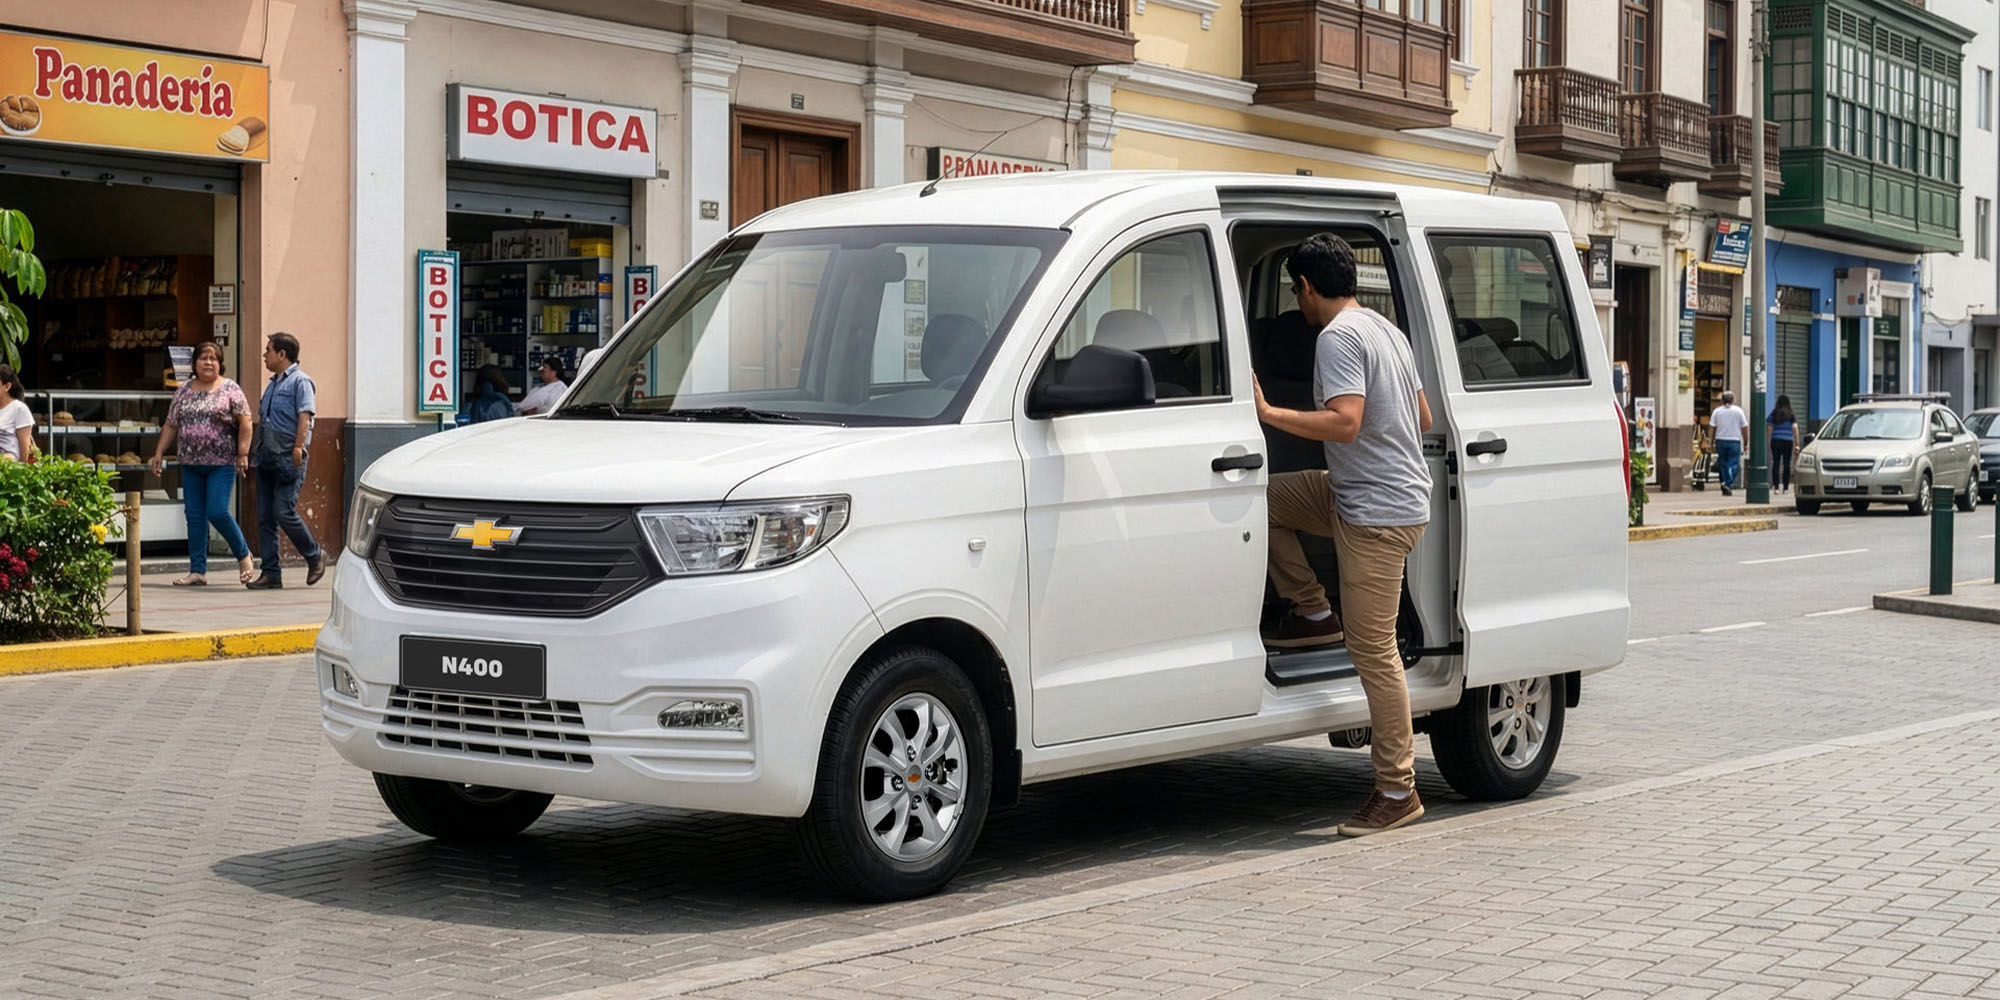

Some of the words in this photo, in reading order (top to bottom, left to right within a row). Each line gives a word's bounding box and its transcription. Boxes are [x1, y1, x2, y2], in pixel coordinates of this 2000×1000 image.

[34, 47, 234, 118] Panadería
[467, 94, 650, 153] BOTICA
[428, 266, 448, 402] BOTICA
[442, 655, 503, 678] N400
